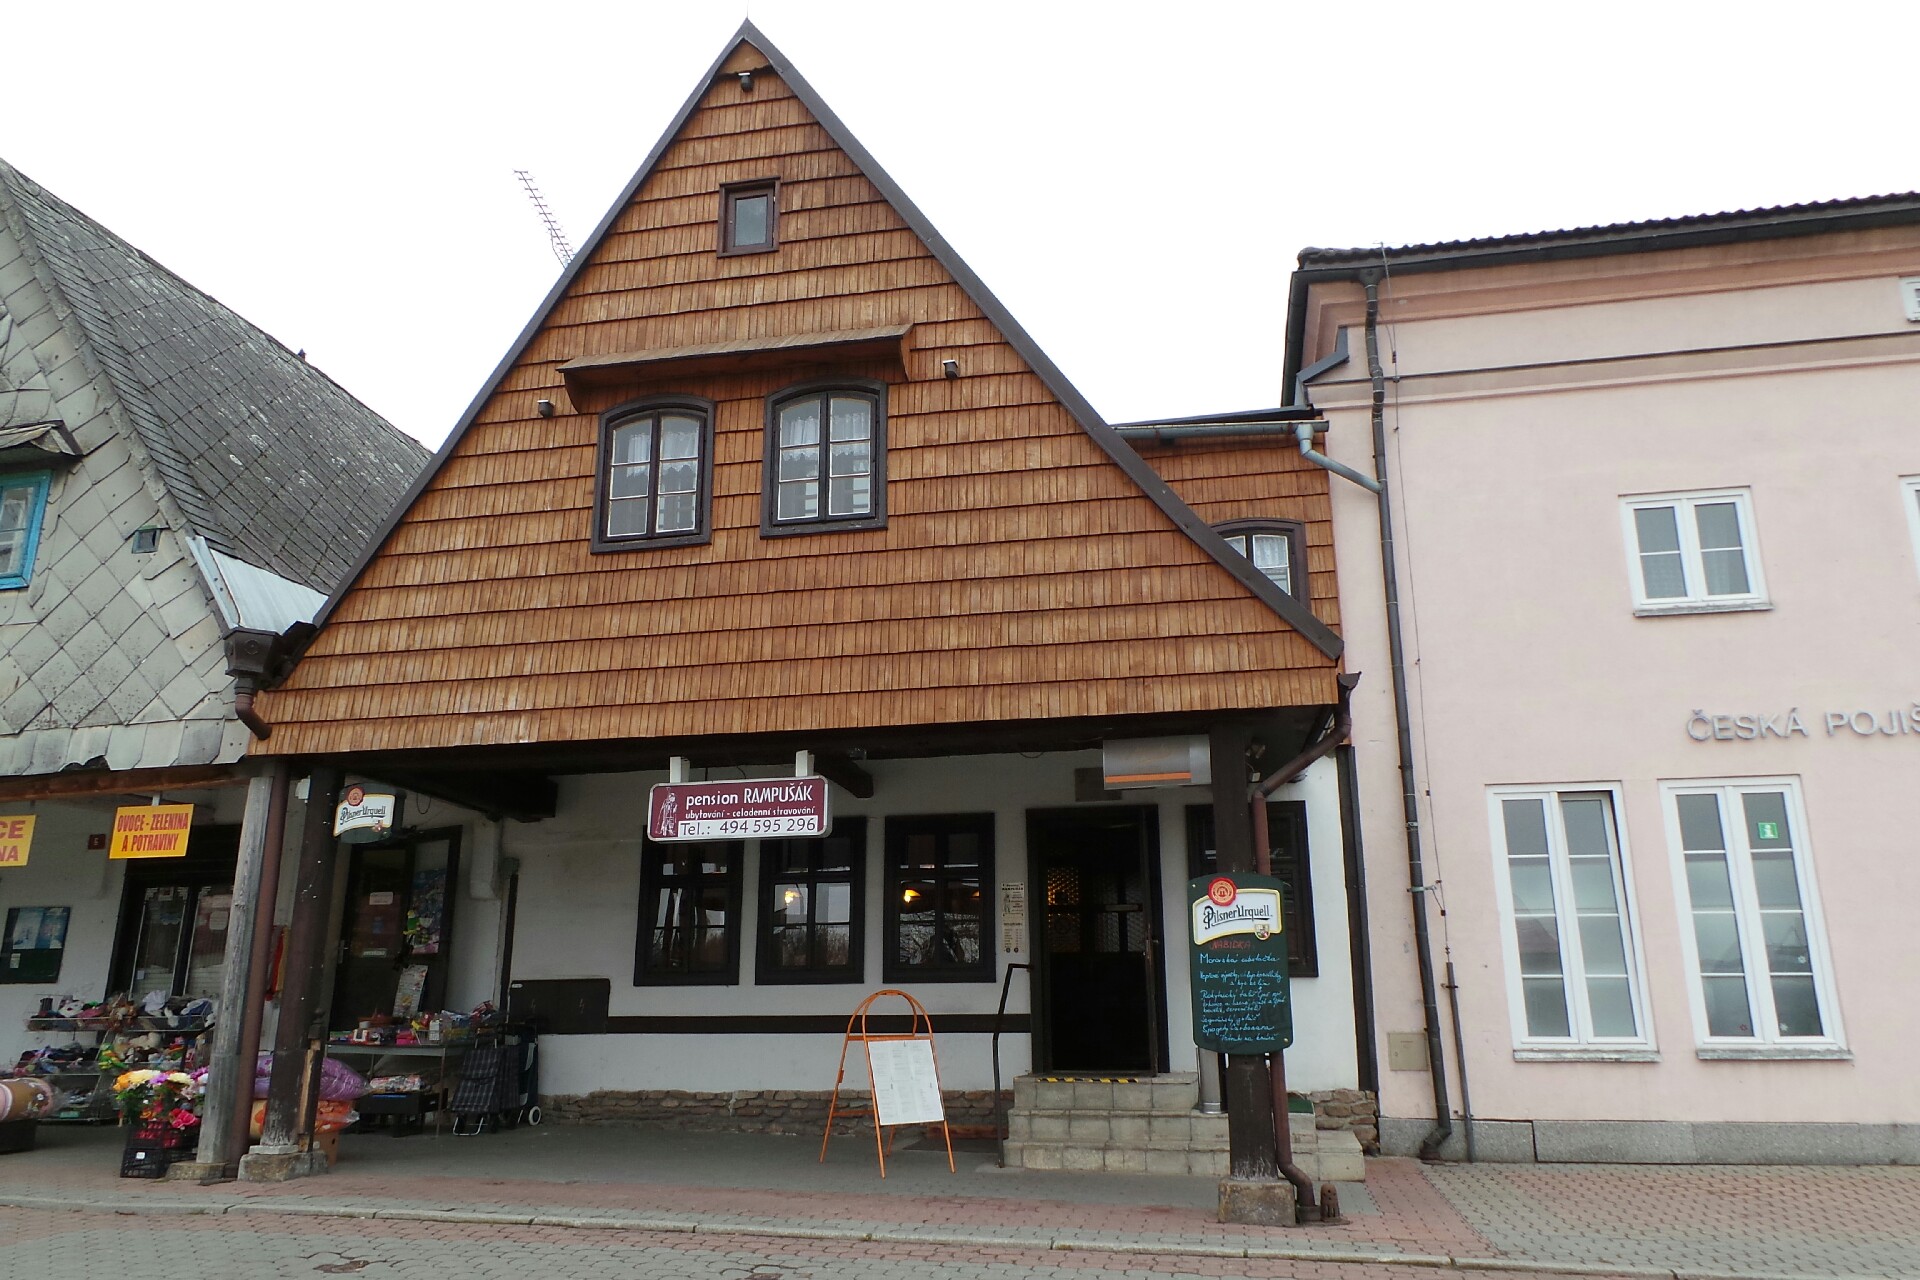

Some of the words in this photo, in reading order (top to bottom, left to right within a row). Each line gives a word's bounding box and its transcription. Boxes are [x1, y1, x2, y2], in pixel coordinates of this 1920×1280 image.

[1687, 707, 1809, 742] ČESKÁ
[686, 790, 738, 810] pension
[743, 781, 813, 805] RAMPUŠÁK
[117, 814, 145, 832] OVOCE
[150, 812, 188, 831] ZELENINA
[685, 809, 725, 821] ubytování
[773, 806, 816, 816] stravování
[681, 822, 711, 836] Tel.:
[719, 820, 749, 834] 494
[752, 819, 781, 833] 595
[786, 818, 815, 832] 296
[121, 834, 128, 852] A
[131, 833, 179, 852] POTRAVINY
[1203, 905, 1237, 930] Pilsner
[1236, 904, 1270, 922] Urquell
